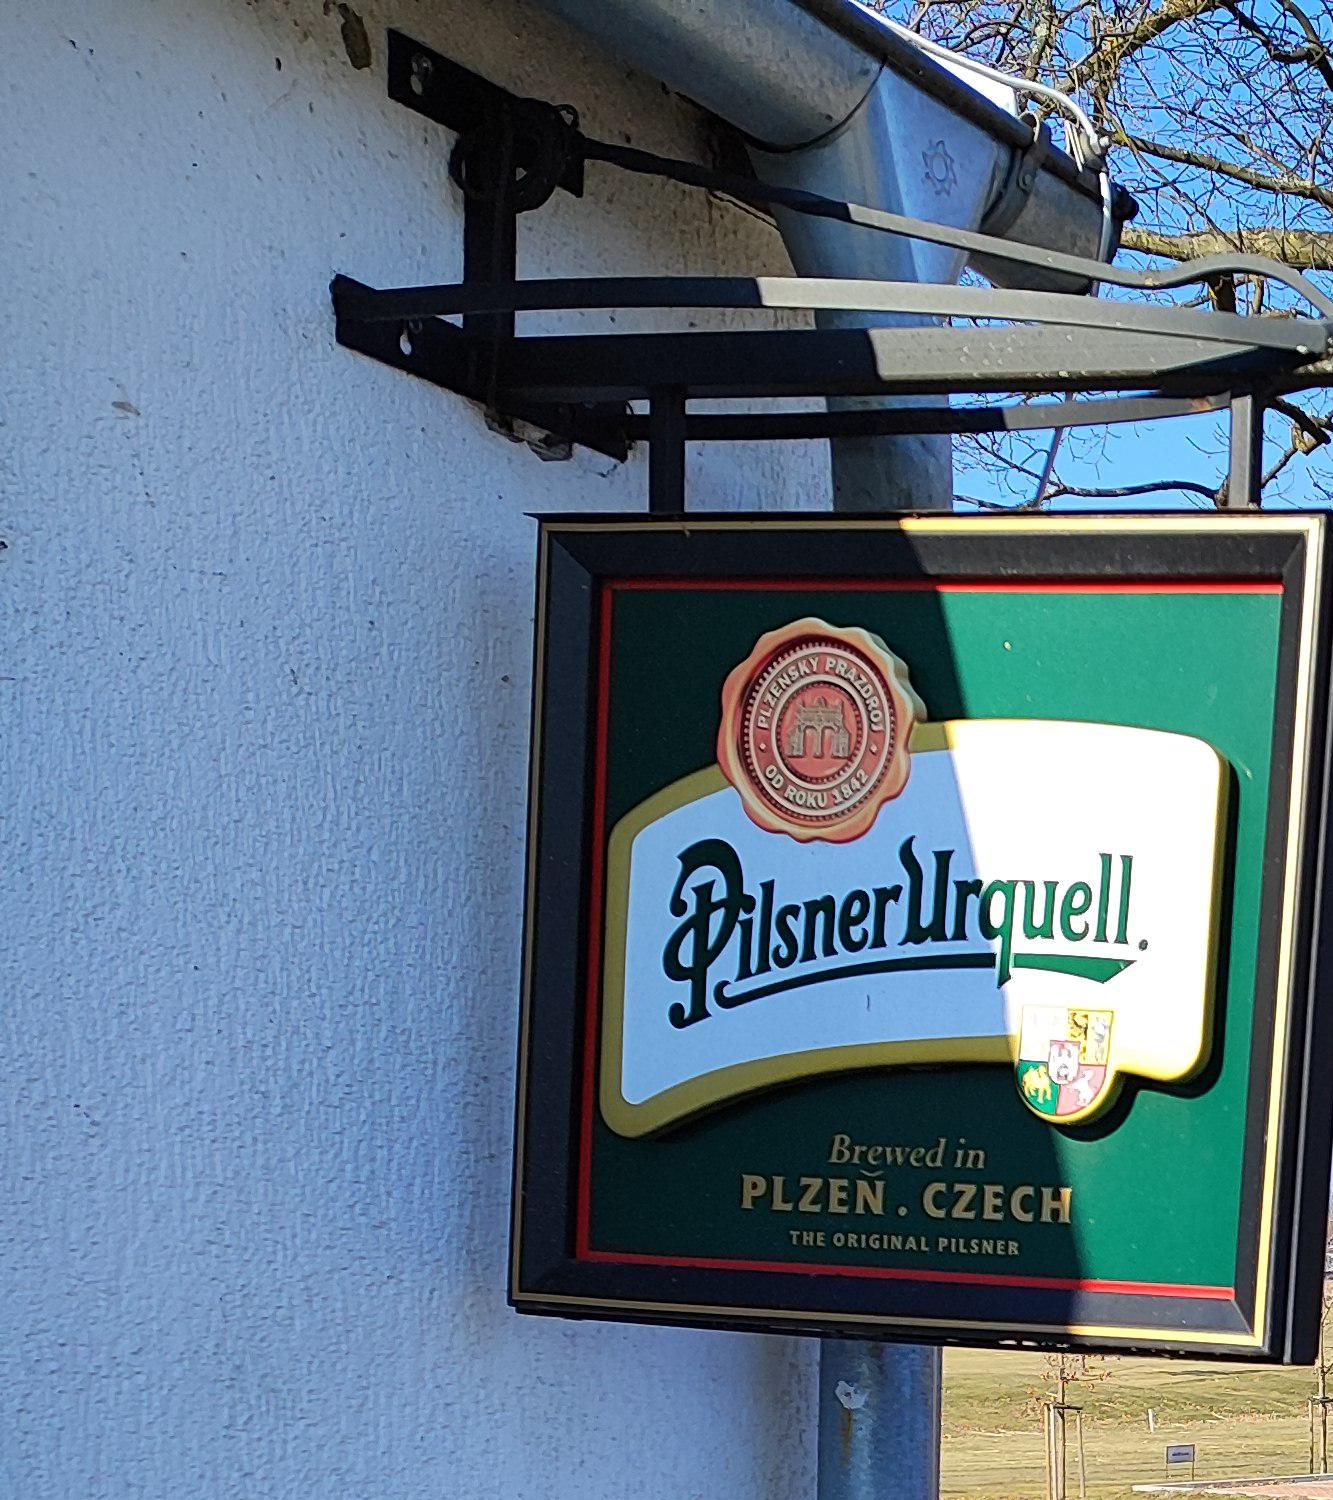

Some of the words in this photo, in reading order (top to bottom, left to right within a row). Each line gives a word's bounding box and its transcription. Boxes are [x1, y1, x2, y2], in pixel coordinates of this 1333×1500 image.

[764, 765, 785, 789] OD
[784, 784, 828, 809] ROKU
[831, 768, 869, 804] 1842
[663, 838, 902, 1029] Pilsner
[828, 1134, 947, 1168] Brewed
[953, 1138, 985, 1169] in
[741, 1169, 885, 1216] PLZEŇ
[922, 1182, 1073, 1224] CZECH
[790, 1231, 826, 1247] THE
[832, 1232, 929, 1251] ORIGINAL
[938, 1236, 1019, 1256] PILSNER
